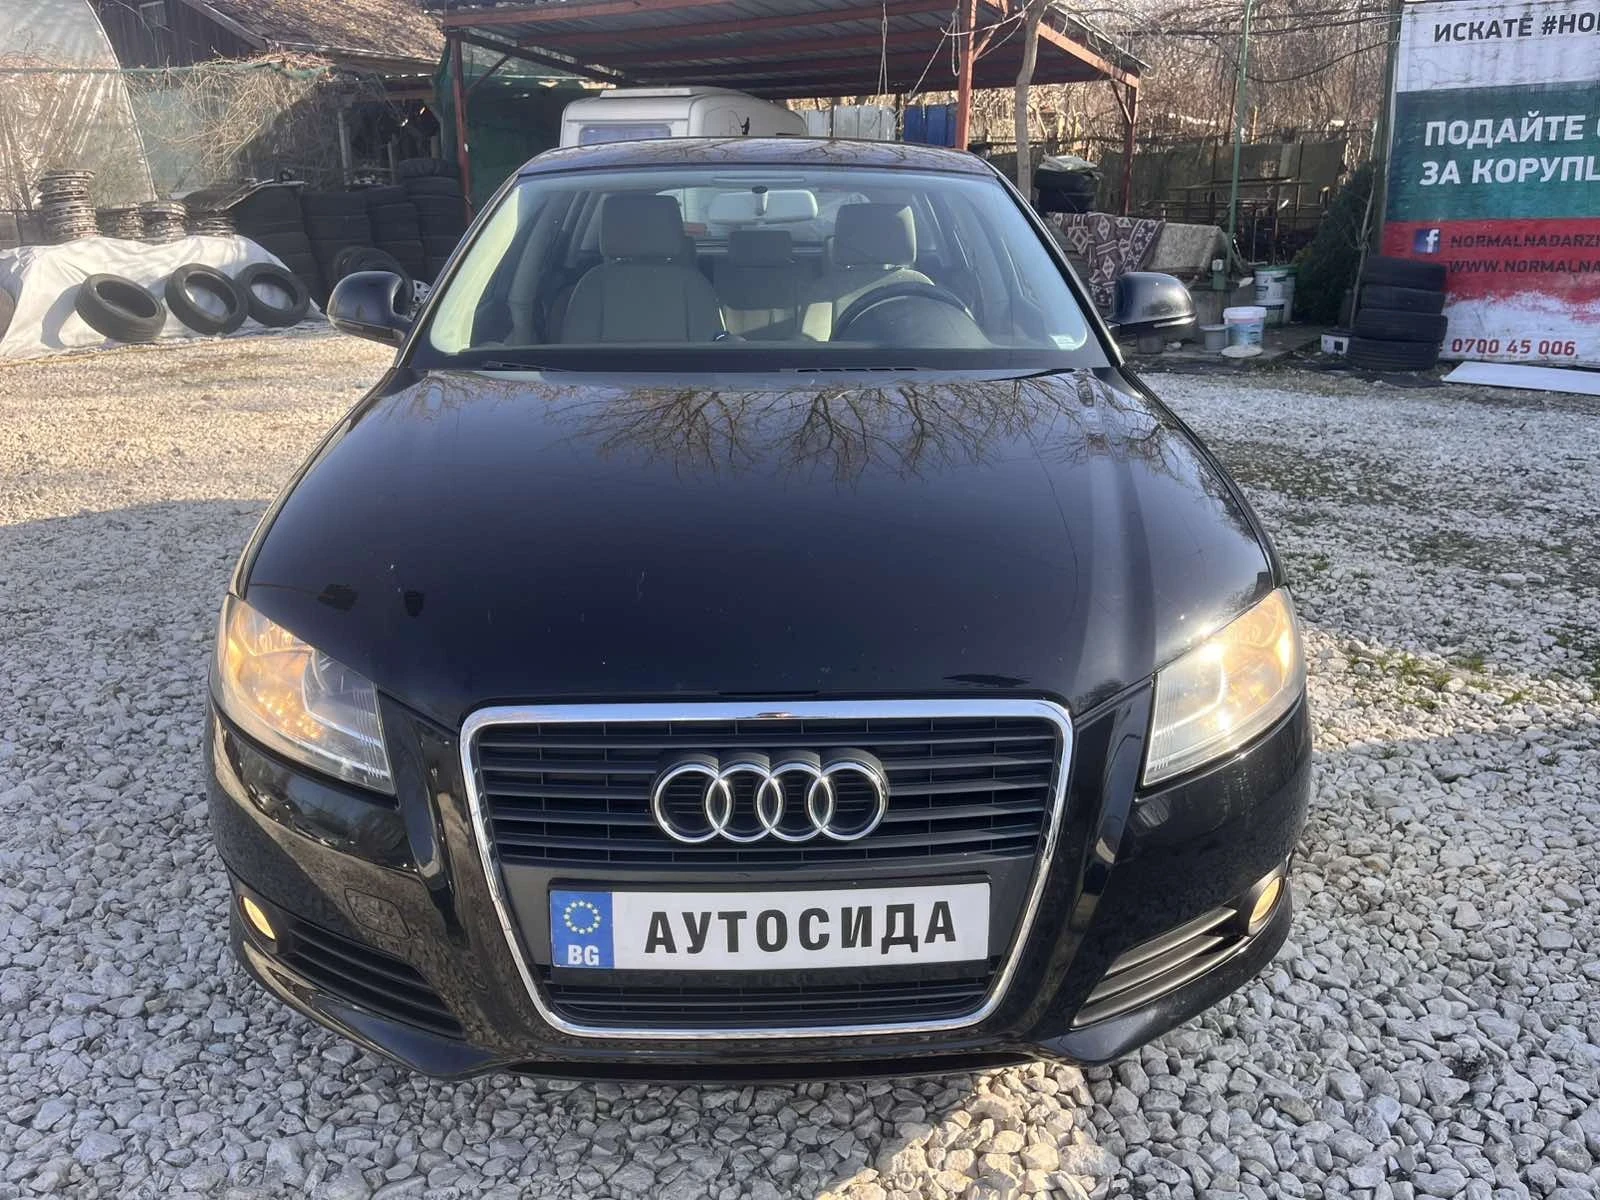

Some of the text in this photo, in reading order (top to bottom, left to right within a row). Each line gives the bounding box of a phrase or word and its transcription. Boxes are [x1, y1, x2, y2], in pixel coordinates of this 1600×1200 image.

[1434, 12, 1600, 42] ИСКАТЕ #НО
[1424, 110, 1586, 150] ПОДАЙТЕ
[1419, 160, 1461, 186] ЗА
[1452, 338, 1576, 356] 0700 45 006
[644, 901, 956, 955] АУТОСИДА
[567, 944, 600, 966] BG
